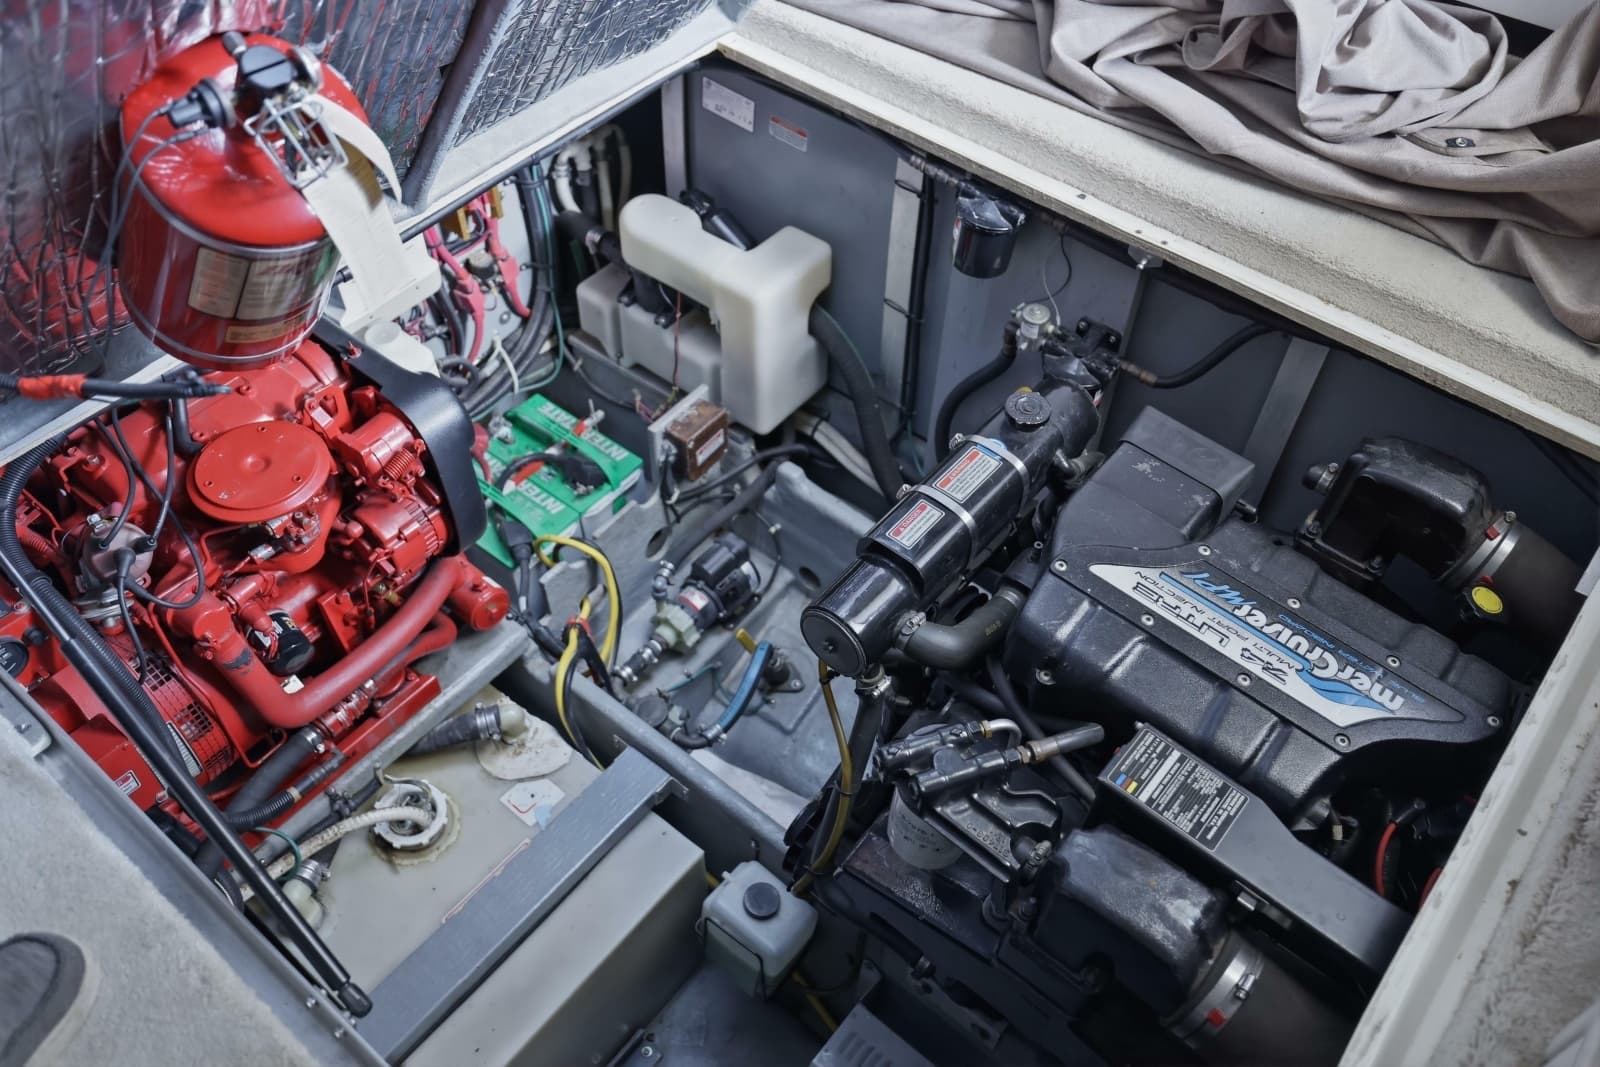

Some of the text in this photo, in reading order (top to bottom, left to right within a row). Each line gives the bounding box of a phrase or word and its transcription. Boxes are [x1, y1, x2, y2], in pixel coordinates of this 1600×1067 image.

[1180, 570, 1257, 606] MPI
[1132, 581, 1230, 648] LITRE
[1134, 570, 1295, 669] MULTI PORT INJECTION
[1278, 613, 1335, 649] INBOARD
